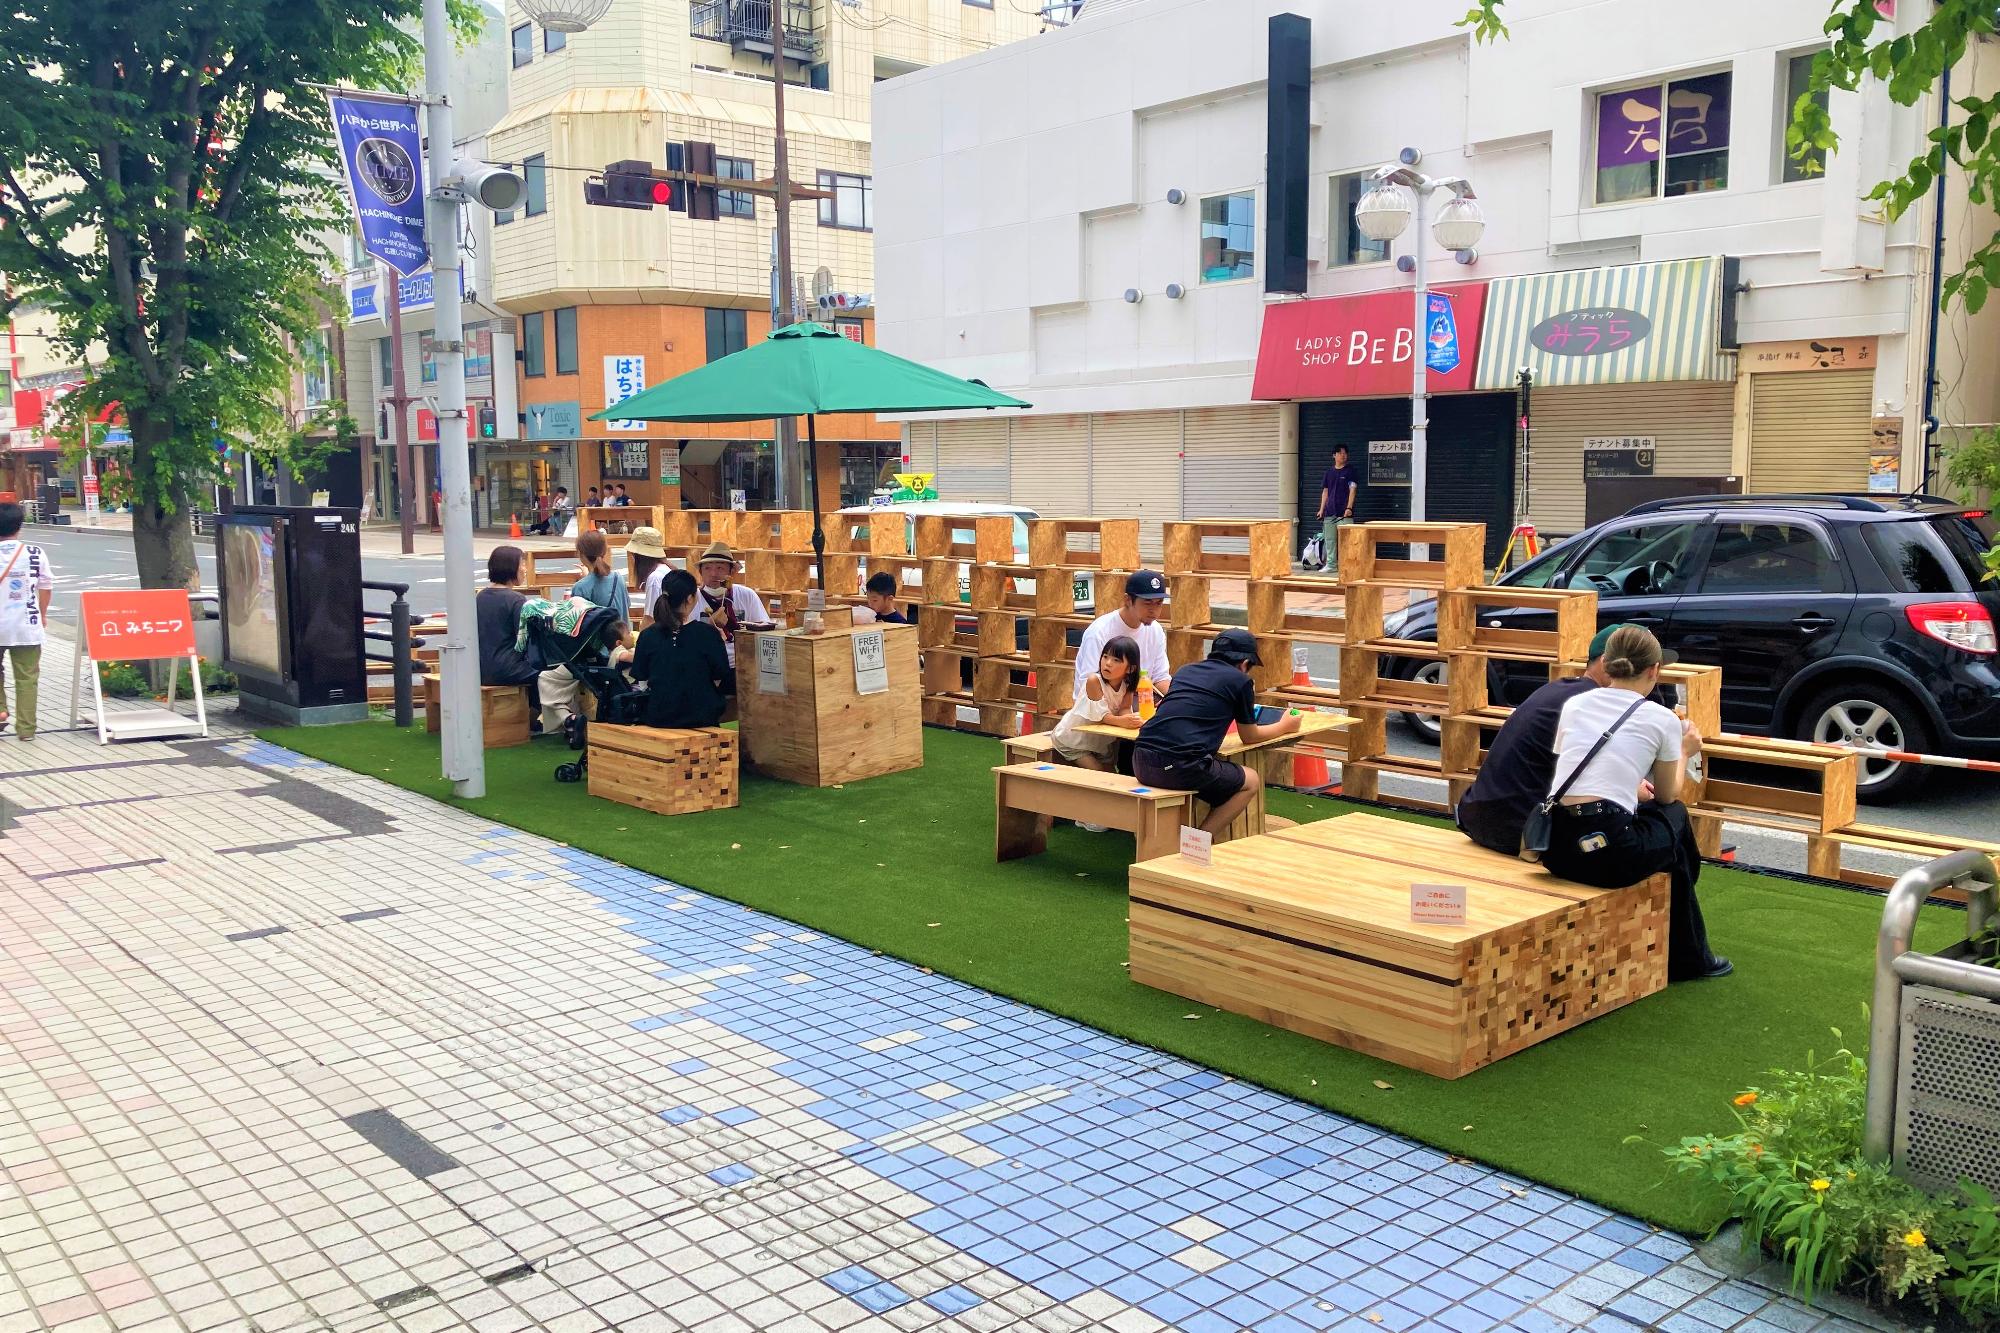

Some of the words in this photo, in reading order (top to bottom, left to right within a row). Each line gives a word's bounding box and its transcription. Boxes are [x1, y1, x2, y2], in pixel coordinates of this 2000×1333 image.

[1543, 319, 1633, 353] みうら
[1295, 335, 1343, 351] LADYS
[1302, 352, 1341, 366] SHOP
[1588, 438, 1651, 449] テナント募集中
[340, 523, 356, 533] 24K
[126, 619, 183, 634] みちニワ
[762, 639, 778, 650] FREE
[858, 635, 880, 646] FREE
[762, 648, 778, 658] Wi-Fi
[859, 645, 880, 656] Wi-Fi
